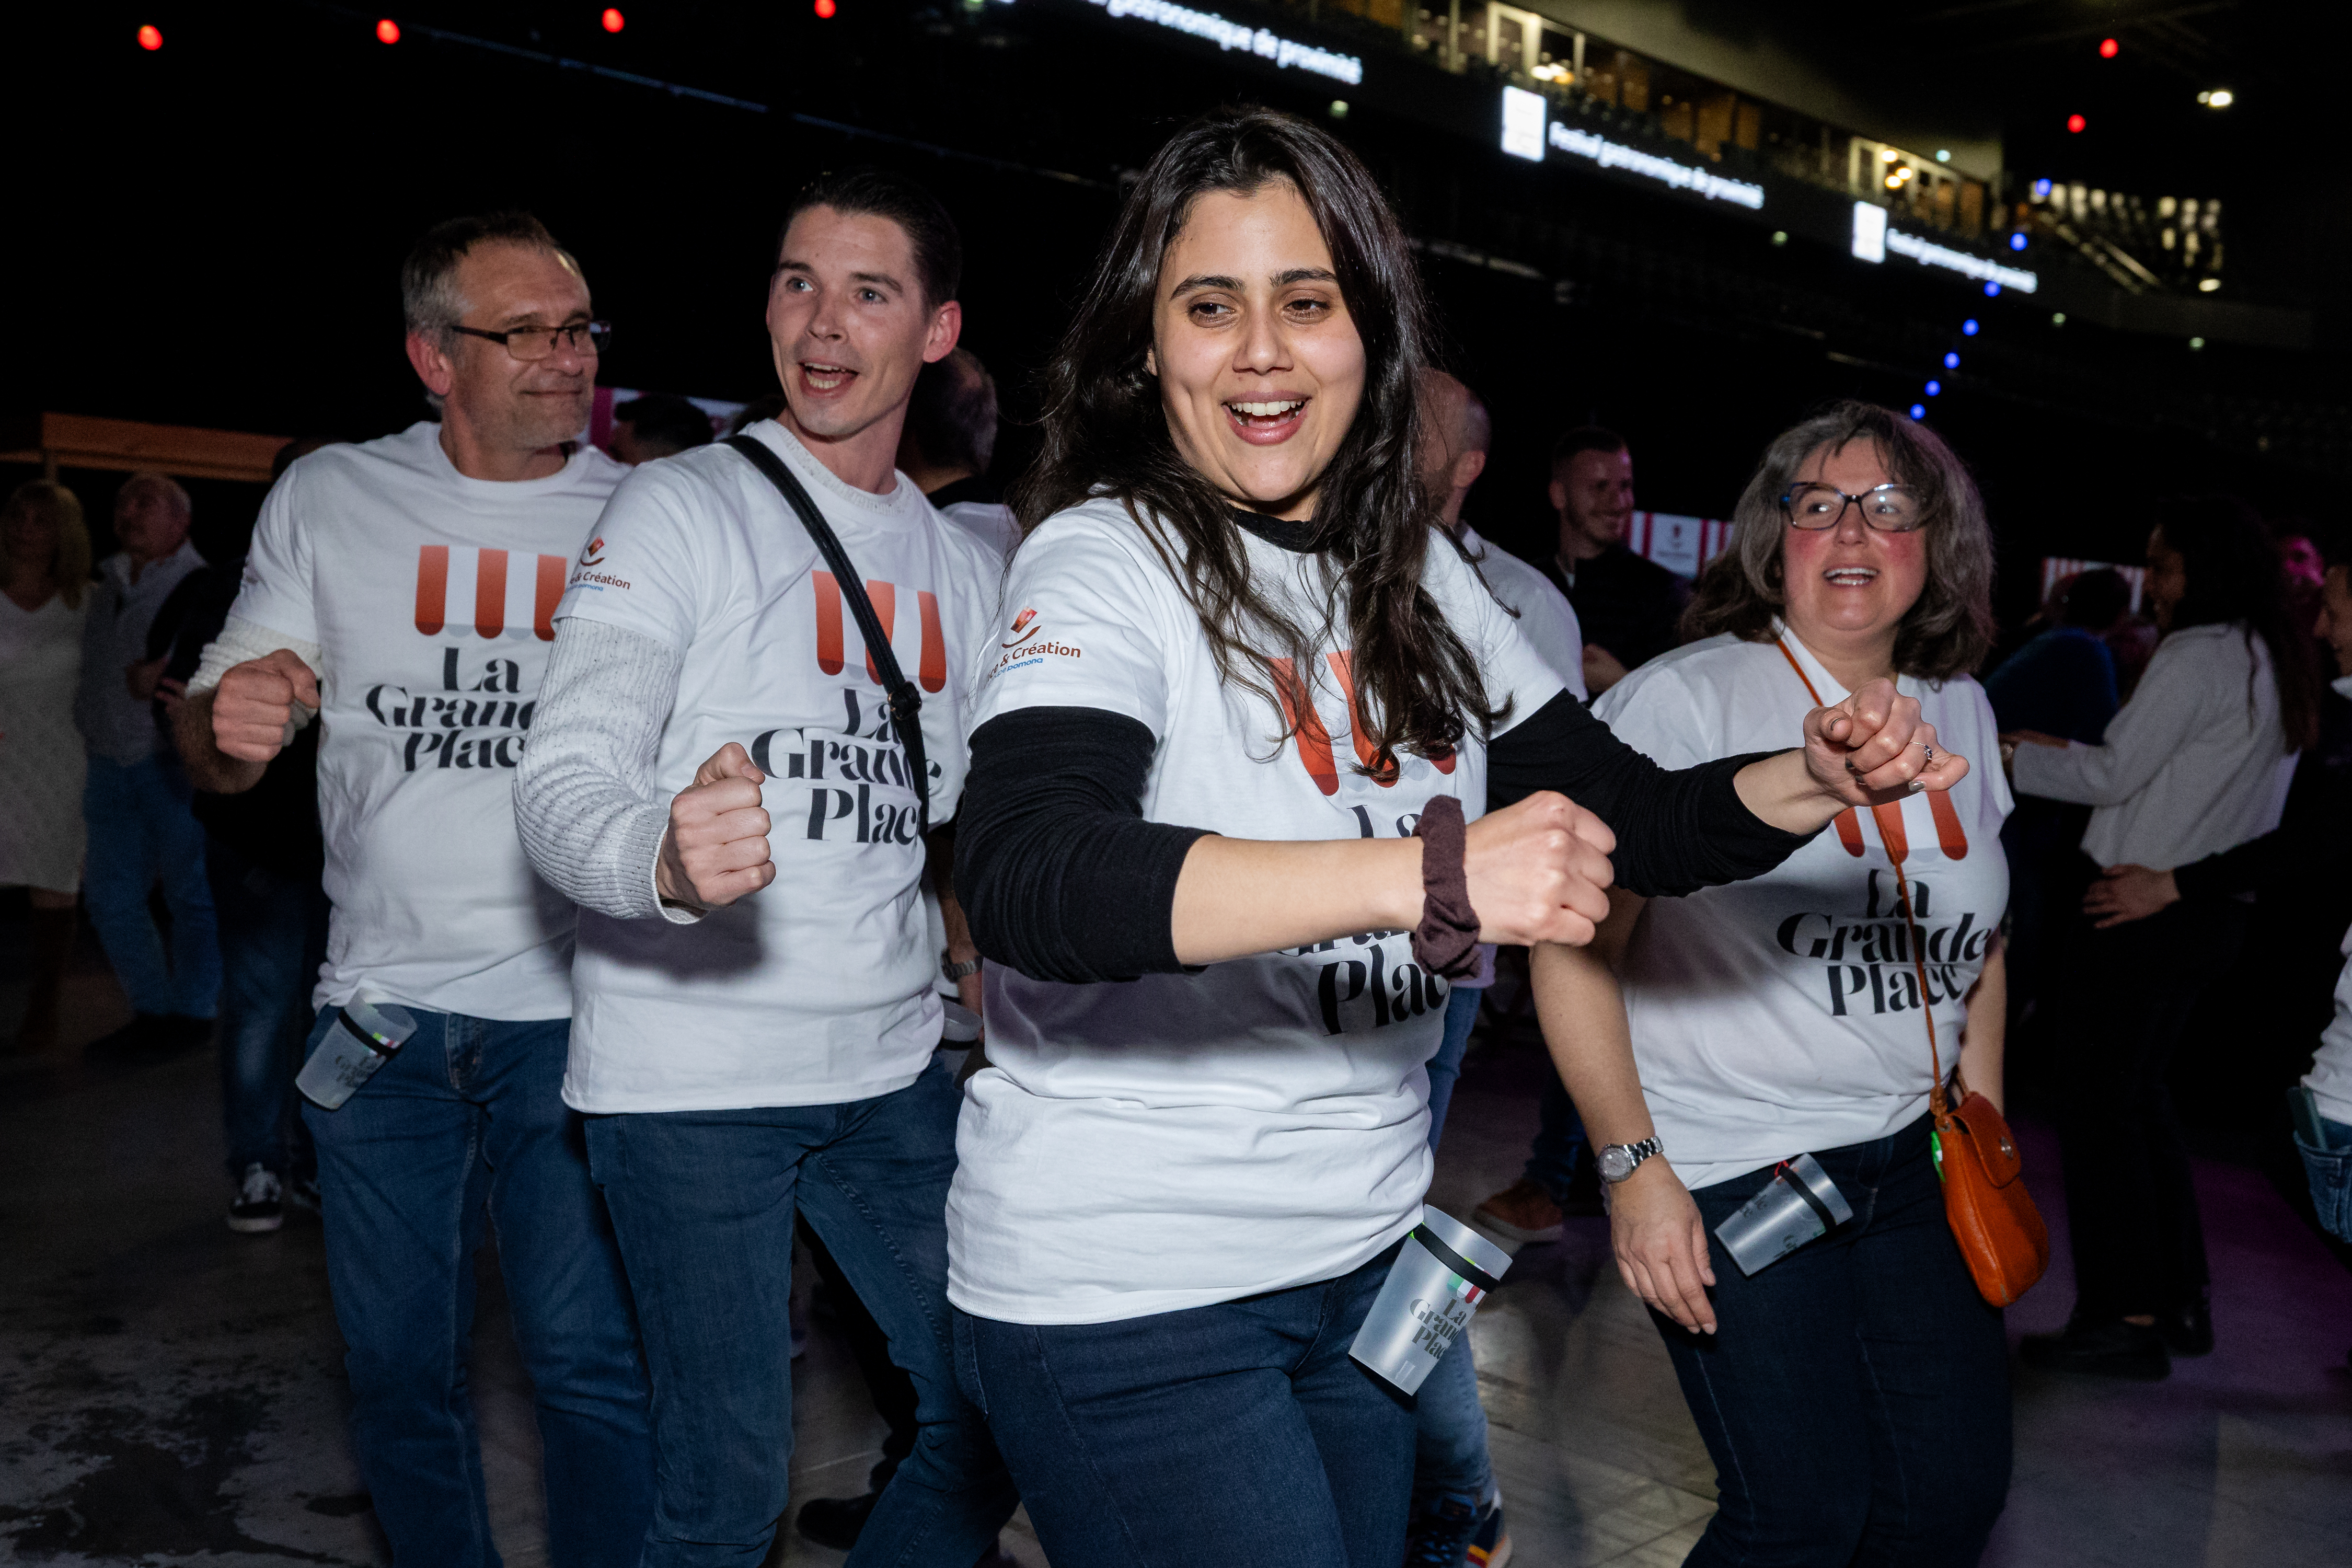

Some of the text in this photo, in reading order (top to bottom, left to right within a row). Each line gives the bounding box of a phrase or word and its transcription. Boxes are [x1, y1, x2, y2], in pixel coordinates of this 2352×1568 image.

[583, 571, 630, 590] Création
[443, 647, 521, 694] La
[1000, 653, 1010, 667] &
[1012, 641, 1081, 660] Création
[1007, 658, 1043, 672] pomona
[366, 684, 537, 731] Gran
[404, 730, 525, 772] Plac
[800, 783, 919, 846] Plac
[1866, 868, 1932, 919] La
[1777, 912, 1993, 963] Grande
[1315, 943, 1449, 1037] Plac
[1410, 1298, 1461, 1343] Gran
[1442, 1299, 1467, 1327] La
[1411, 1326, 1447, 1360] Plac
